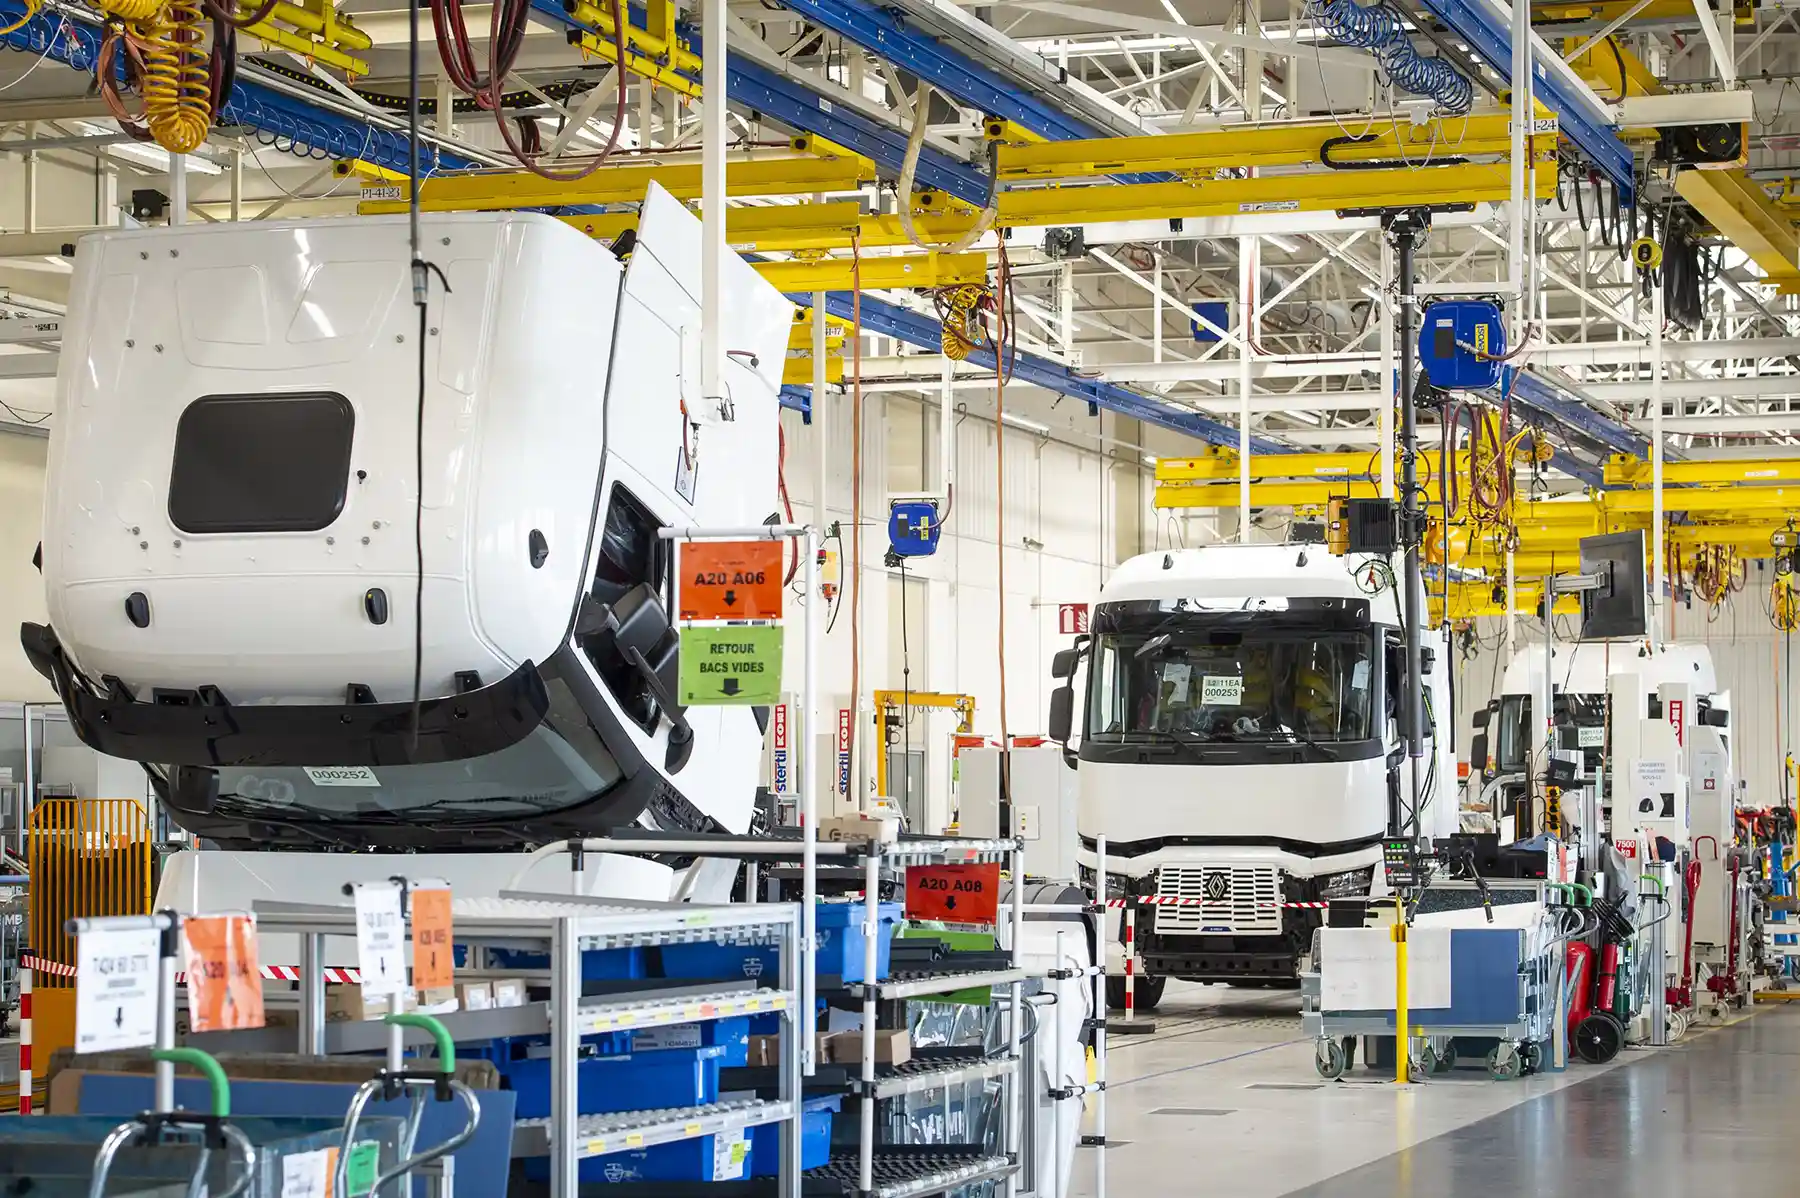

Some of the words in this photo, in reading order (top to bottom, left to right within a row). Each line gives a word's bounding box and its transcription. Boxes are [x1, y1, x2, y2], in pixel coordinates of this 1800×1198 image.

[695, 573, 727, 586] A20
[732, 572, 765, 585] A06
[710, 643, 754, 654] RETOUR
[700, 662, 728, 673] BACS
[732, 662, 764, 673] VIDES
[1205, 689, 1238, 697] 000253
[776, 706, 785, 747] KONI
[840, 711, 848, 750] KONI
[311, 770, 370, 779] 000252
[775, 750, 787, 793] stertil
[1617, 840, 1635, 848] 7500
[919, 878, 948, 891] A20
[952, 880, 983, 893] A08
